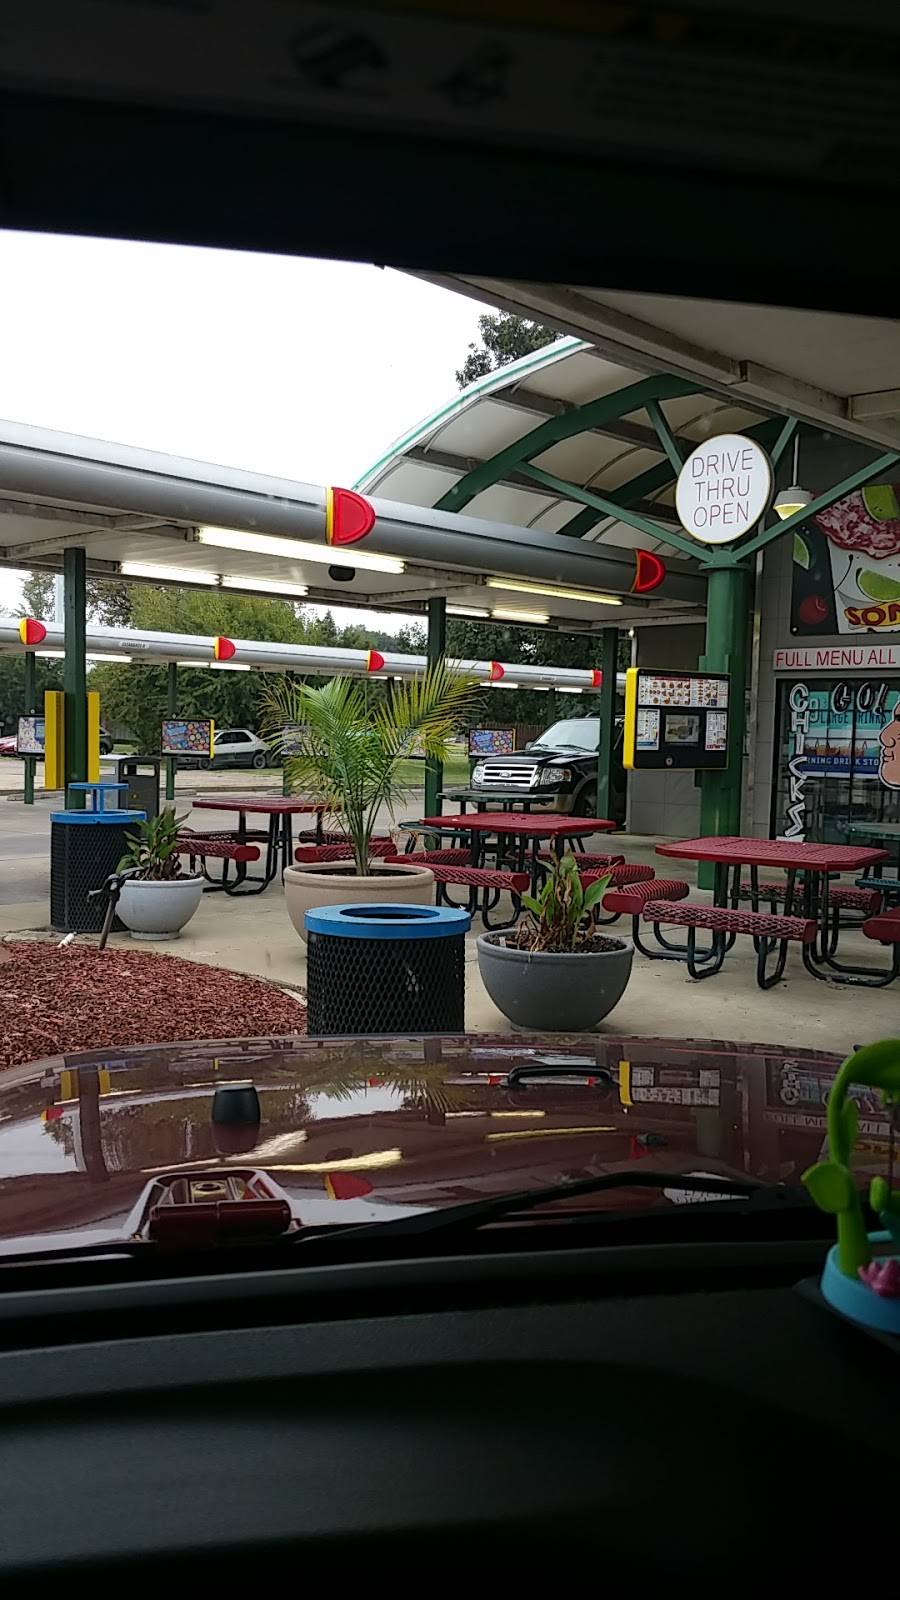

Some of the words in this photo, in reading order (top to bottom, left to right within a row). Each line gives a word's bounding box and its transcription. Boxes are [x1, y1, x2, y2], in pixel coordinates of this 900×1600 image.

[692, 448, 753, 478] DRIVE
[694, 475, 750, 502] THRU
[693, 501, 749, 528] OPEN
[776, 651, 811, 667] FULL
[816, 650, 863, 666] MENU
[867, 648, 897, 665] ALL
[831, 682, 888, 715] GO!
[821, 710, 848, 724] LRGE
[834, 757, 861, 766] DRIK
